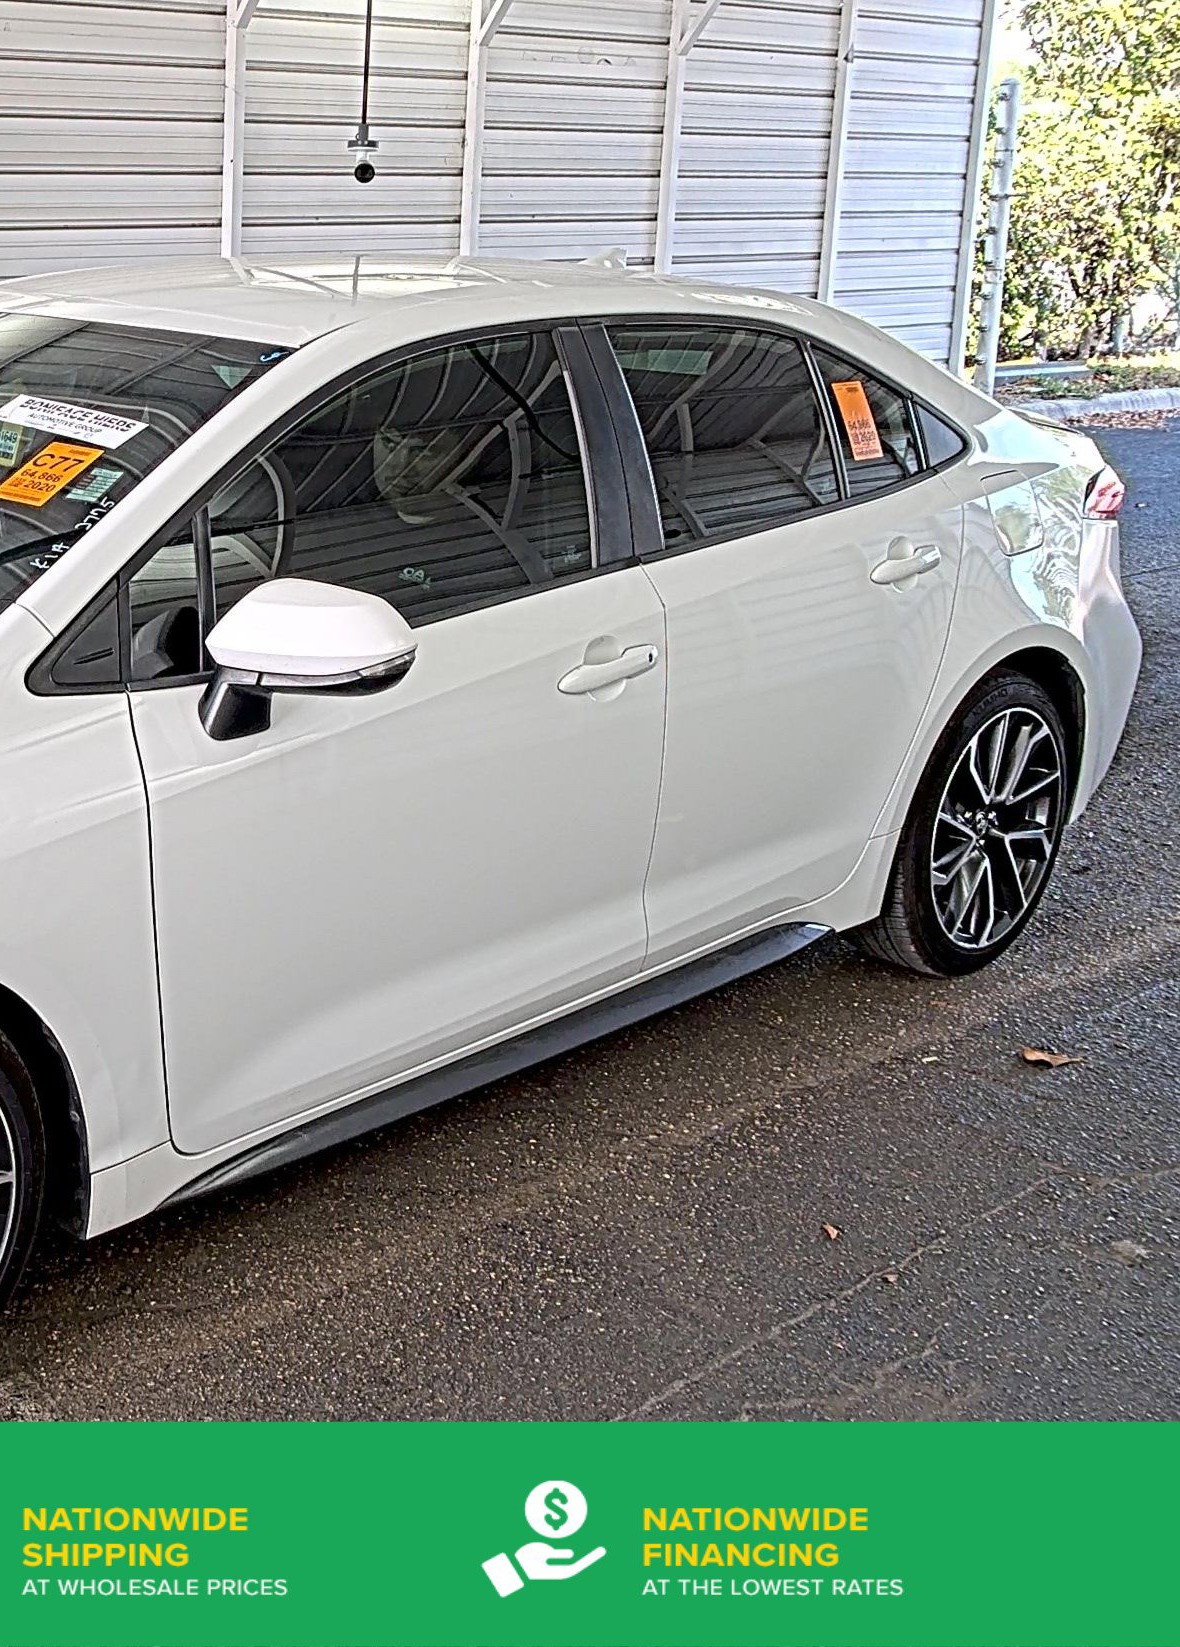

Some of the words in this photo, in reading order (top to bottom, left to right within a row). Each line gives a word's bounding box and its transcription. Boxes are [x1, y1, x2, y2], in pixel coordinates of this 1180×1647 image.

[20, 399, 93, 421] BONIFACE
[87, 414, 137, 432] HIERS
[28, 413, 76, 427] AUTOMOTIVE
[32, 453, 85, 473] C77
[21, 468, 63, 482] 64,866
[23, 480, 57, 493] 2020
